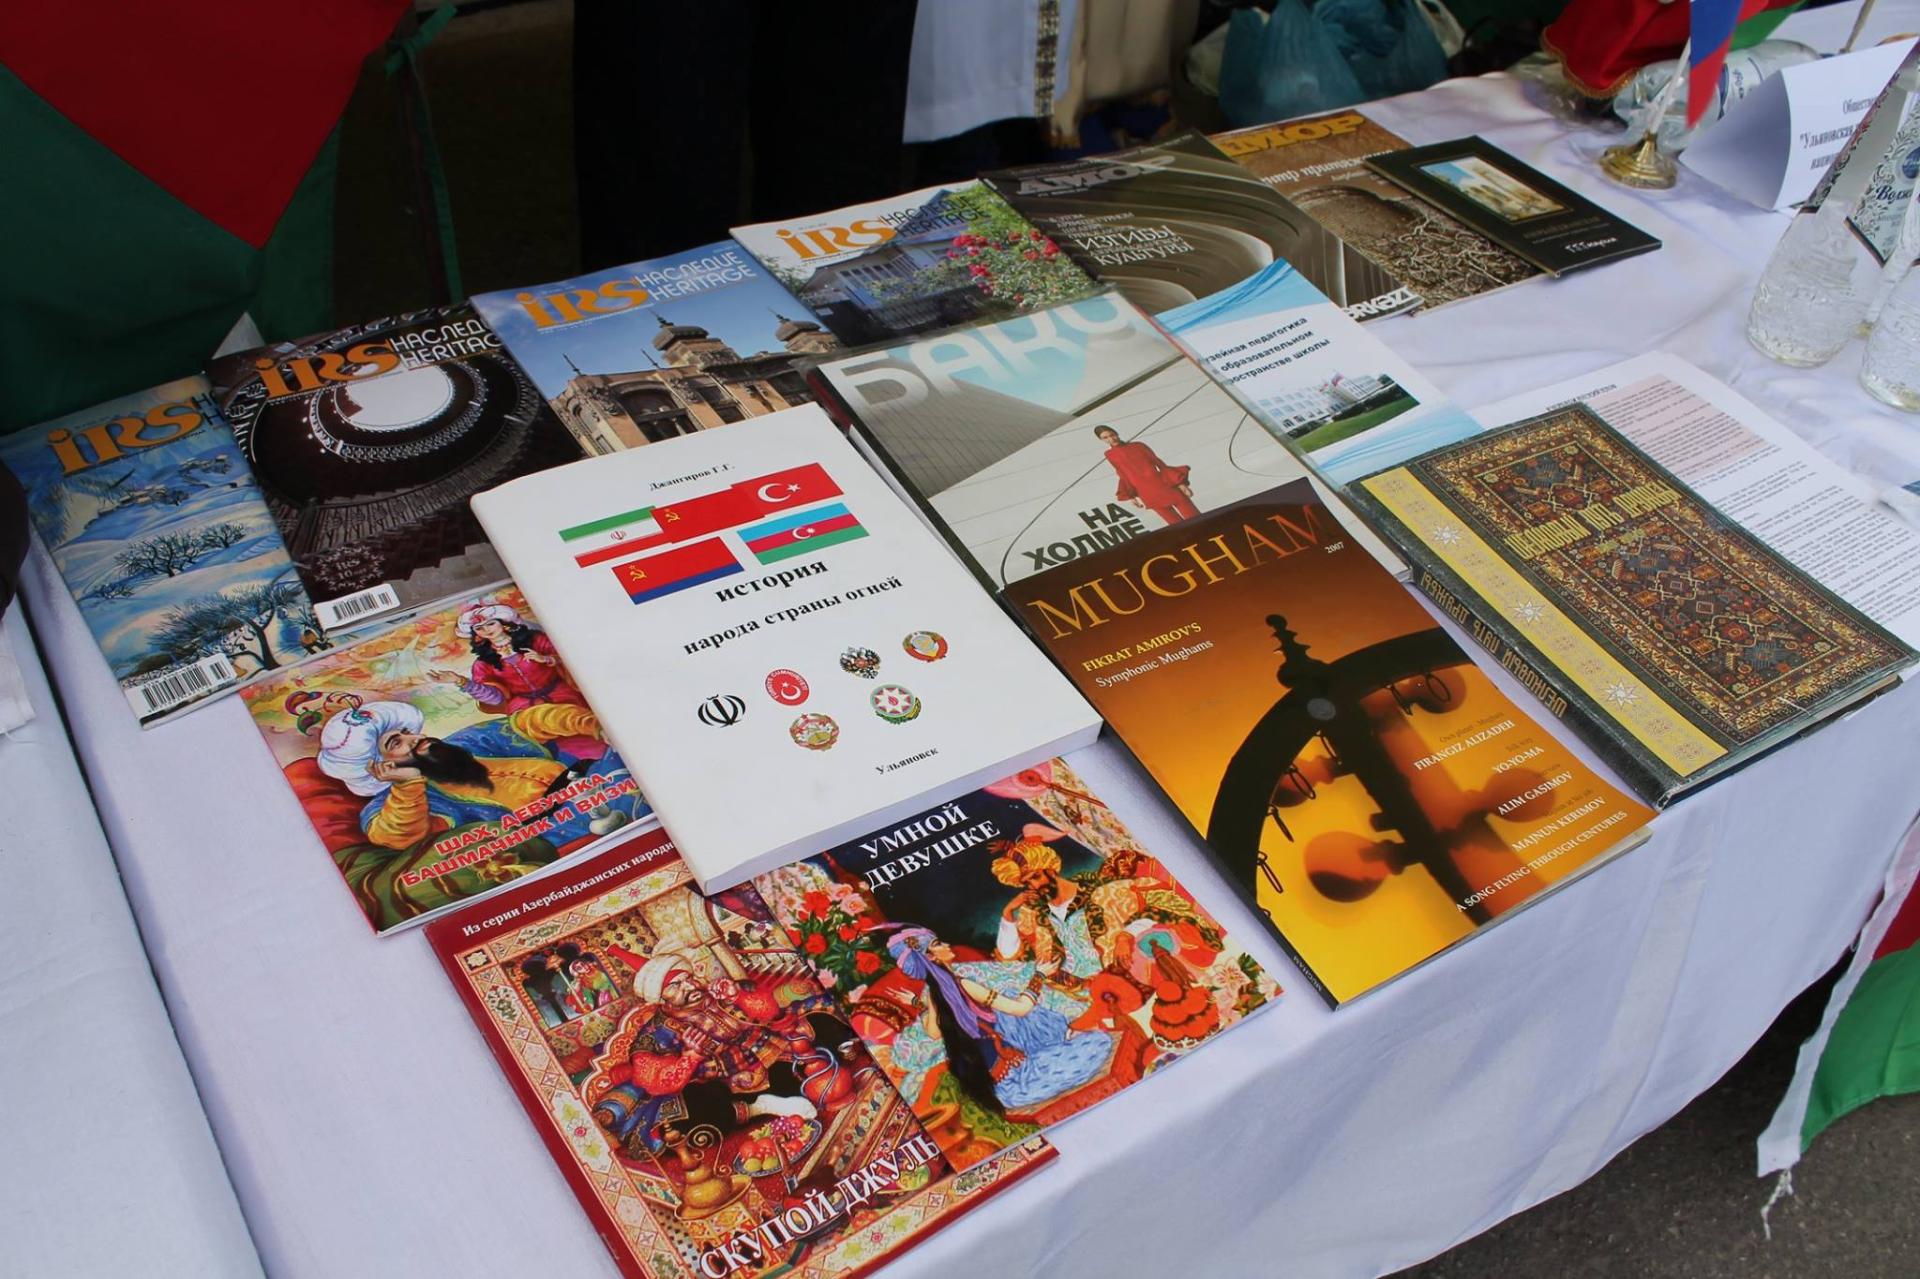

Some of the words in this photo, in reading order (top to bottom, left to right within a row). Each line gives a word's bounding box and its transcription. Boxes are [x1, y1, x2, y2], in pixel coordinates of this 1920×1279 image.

[895, 206, 992, 239] HERITAGE
[1075, 225, 1177, 250] ИЗГИБЫ
[1095, 240, 1195, 266] КУЛЬТУРЫ
[648, 264, 757, 301] HERITAGE
[1221, 330, 1314, 372] образовательном
[1248, 317, 1308, 349] педагогика
[1293, 338, 1330, 360] школы
[649, 467, 712, 491] Джангиров
[1083, 502, 1134, 530] НА
[1023, 518, 1151, 571] ХОЛМЕ
[1325, 540, 1345, 554] 2007
[714, 558, 828, 603] история
[1027, 504, 1333, 640] MUGHAM
[683, 615, 760, 656] народа
[763, 591, 842, 628] страны
[845, 575, 904, 603] огней
[1082, 644, 1133, 673] FIKRAT
[1136, 621, 1202, 656] AMIROV'S
[1096, 657, 1160, 688] Symphonic
[1159, 637, 1214, 670] Mughams
[875, 747, 939, 775] Ульяновск
[1414, 742, 1466, 770] FIRANGIZ
[1466, 719, 1516, 748] ALIZADEH
[1493, 746, 1544, 774] YO-YO-MA
[435, 824, 499, 855] ШАХ,
[501, 773, 613, 831] ДЕВУШКА,
[1498, 796, 1526, 816] ALIM
[1525, 771, 1573, 800] GASIMOV
[401, 818, 554, 887] БАШМАЧНИК
[554, 807, 576, 826] И
[859, 803, 969, 859] УМНОЙ
[1511, 821, 1559, 852] MAJNUN
[1558, 796, 1606, 827] KERIMOV
[864, 820, 1001, 893] ДЕВУШКЕ
[1456, 902, 1466, 913] A
[1465, 885, 1495, 906] SONG
[1494, 865, 1531, 891] FLYING
[1528, 839, 1578, 870] THROUGH
[1576, 810, 1628, 843] CENTURIES
[461, 923, 481, 937] Из
[482, 908, 521, 930] серии
[522, 861, 631, 912] Азербайджанских
[700, 1188, 839, 1279] СКУПОЙ
[836, 1134, 941, 1212] ДЖУЛЬ
